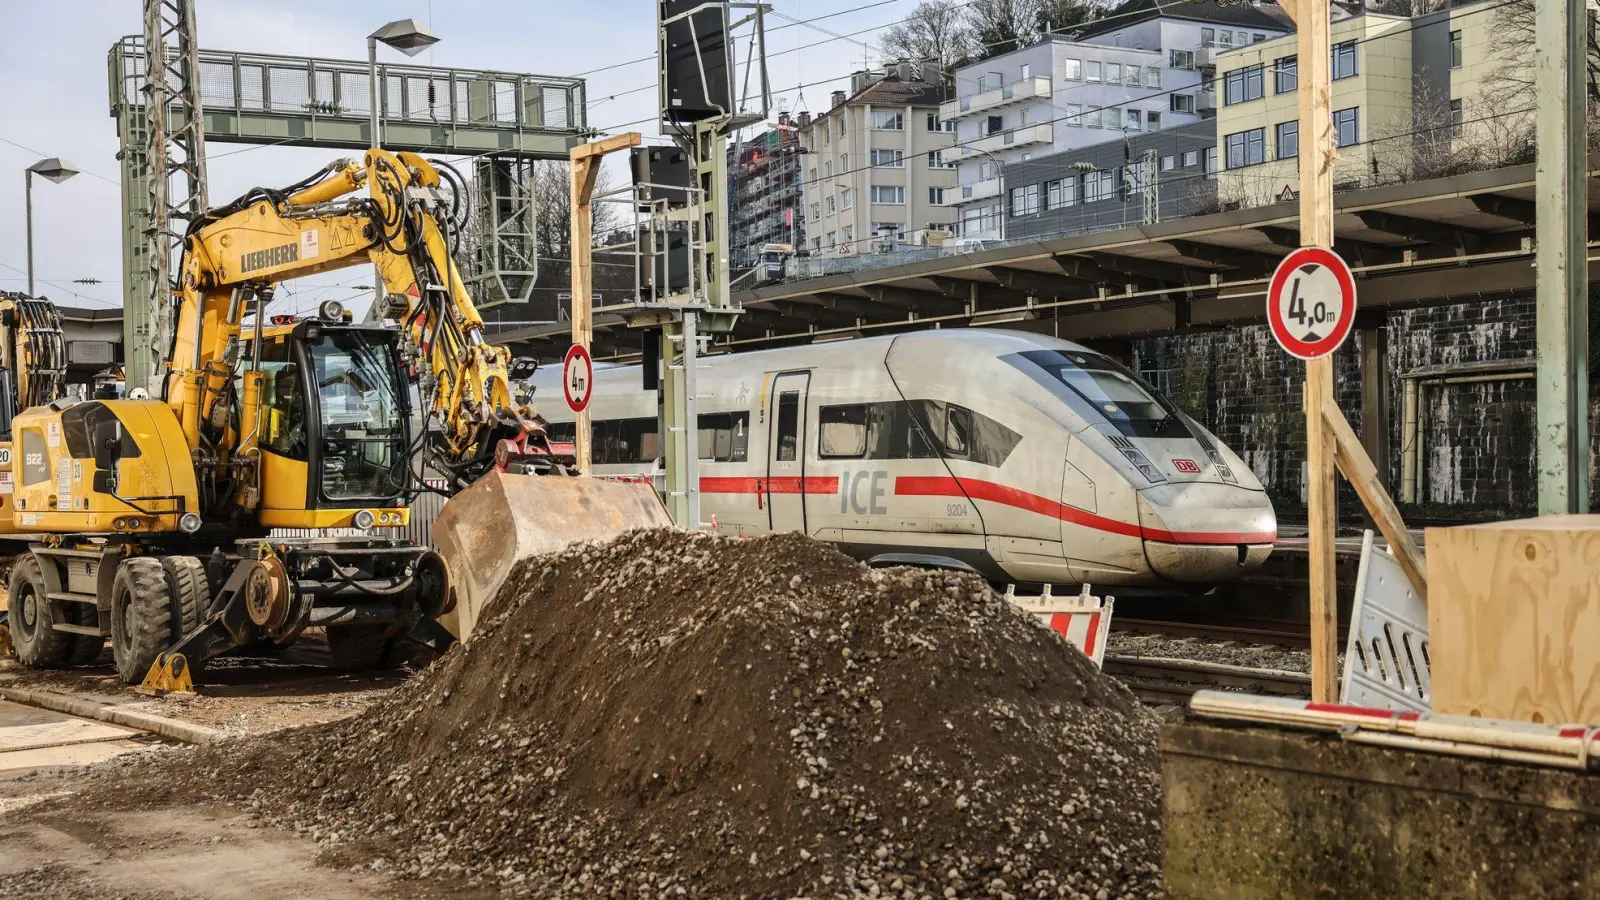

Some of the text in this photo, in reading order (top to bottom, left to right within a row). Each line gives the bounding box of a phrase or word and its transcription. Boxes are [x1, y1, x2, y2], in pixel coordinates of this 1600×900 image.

[241, 242, 298, 273] LIEBHERR
[737, 418, 744, 437] 1
[26, 453, 42, 465] 922
[1175, 460, 1198, 471] DB
[840, 470, 888, 516] ICE
[946, 504, 968, 517] 9204
